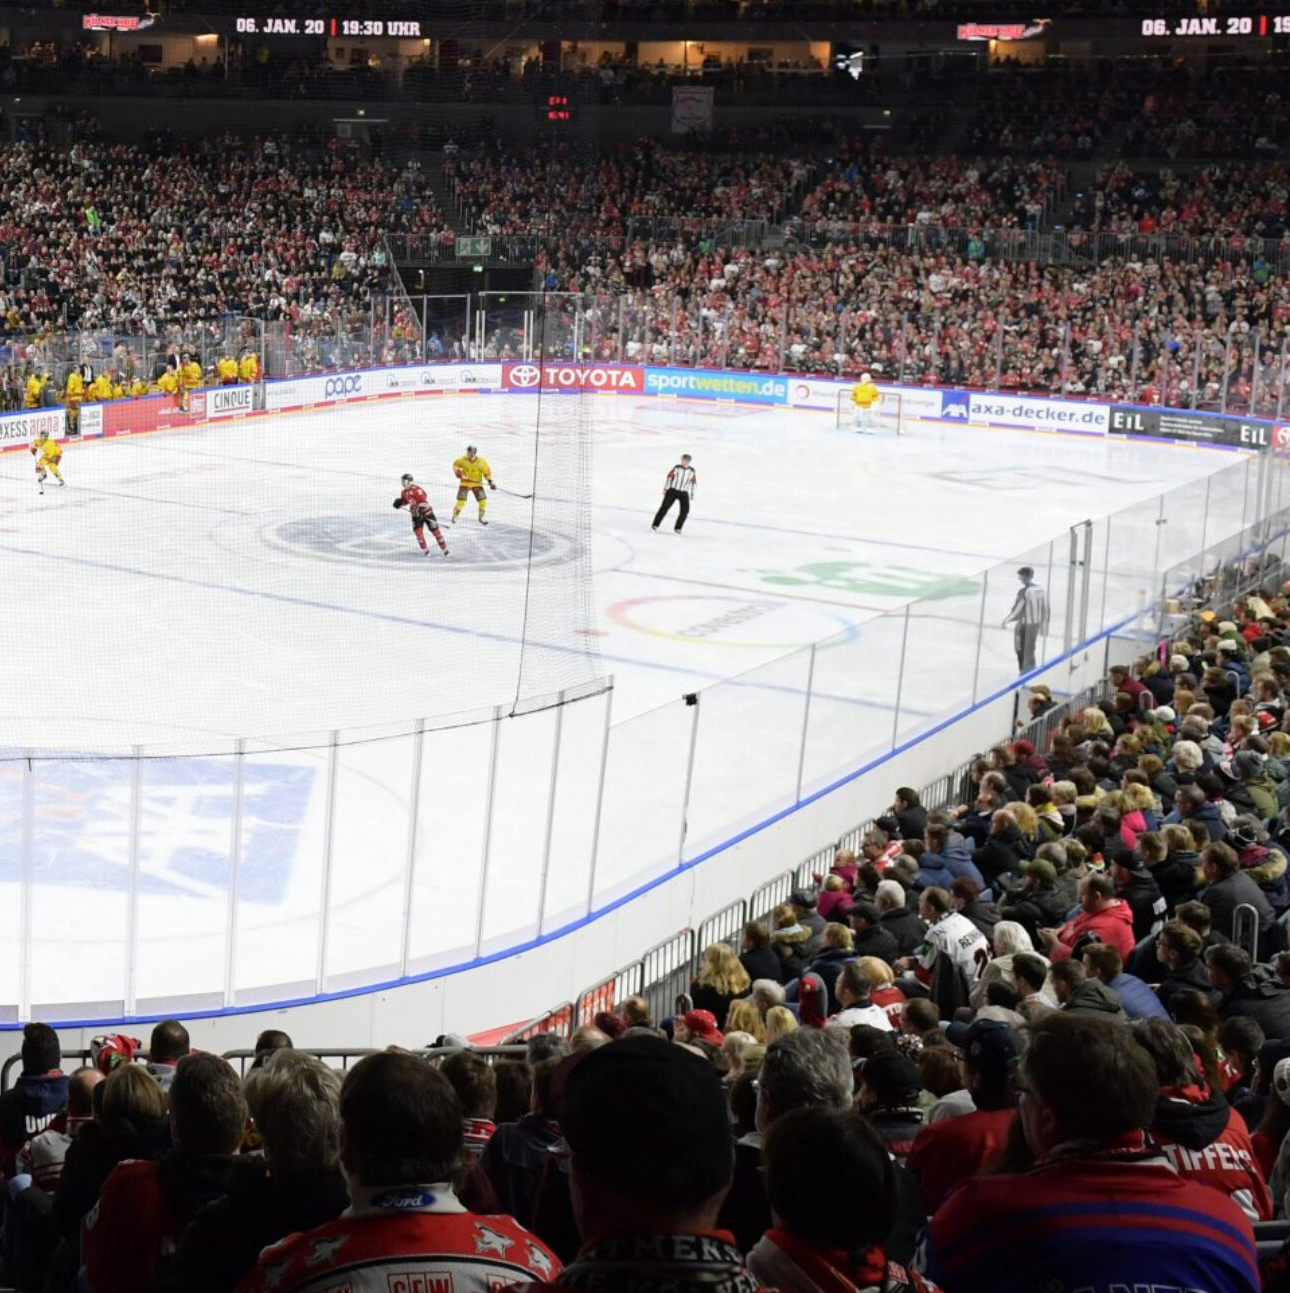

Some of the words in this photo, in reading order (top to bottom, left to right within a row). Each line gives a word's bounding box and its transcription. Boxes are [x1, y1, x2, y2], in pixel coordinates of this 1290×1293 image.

[236, 18, 258, 33] 06.
[263, 18, 300, 34] JAN.
[304, 19, 325, 34] 20
[342, 20, 383, 35] 19:30
[387, 21, 421, 36] UHR
[1142, 19, 1170, 36] 06.
[1175, 18, 1221, 35] JAN.
[1226, 17, 1252, 34] 20
[545, 368, 636, 388] TOYOTA
[647, 373, 786, 397] sportwetten.de
[213, 389, 250, 410] CINQUE
[972, 403, 1105, 425] axa-decker.de
[382, 1192, 424, 1208] Ford
